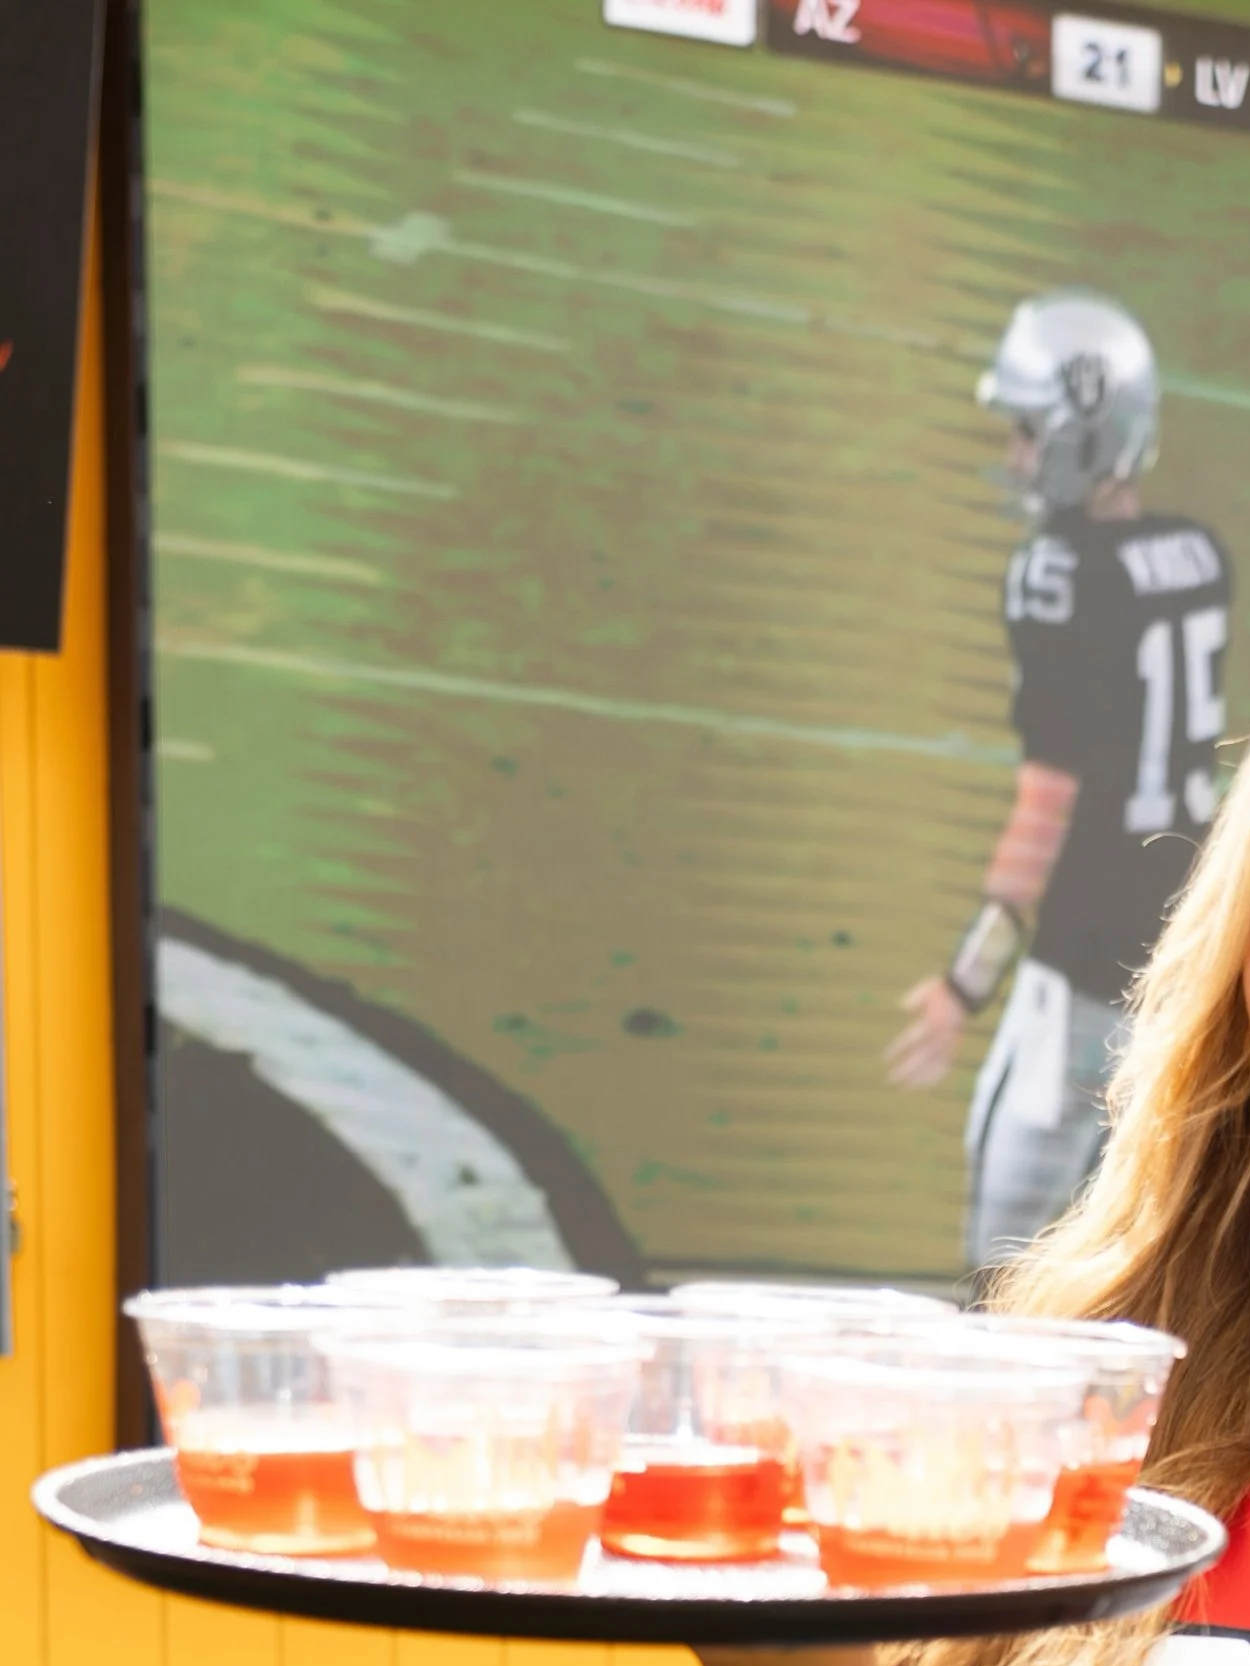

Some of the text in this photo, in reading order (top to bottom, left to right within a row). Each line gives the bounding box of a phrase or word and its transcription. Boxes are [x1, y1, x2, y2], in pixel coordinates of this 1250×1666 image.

[792, 0, 862, 44] AZ
[1079, 41, 1132, 90] 21
[1194, 56, 1250, 110] LV
[1005, 535, 1078, 624] 15
[1123, 606, 1227, 833] 15
